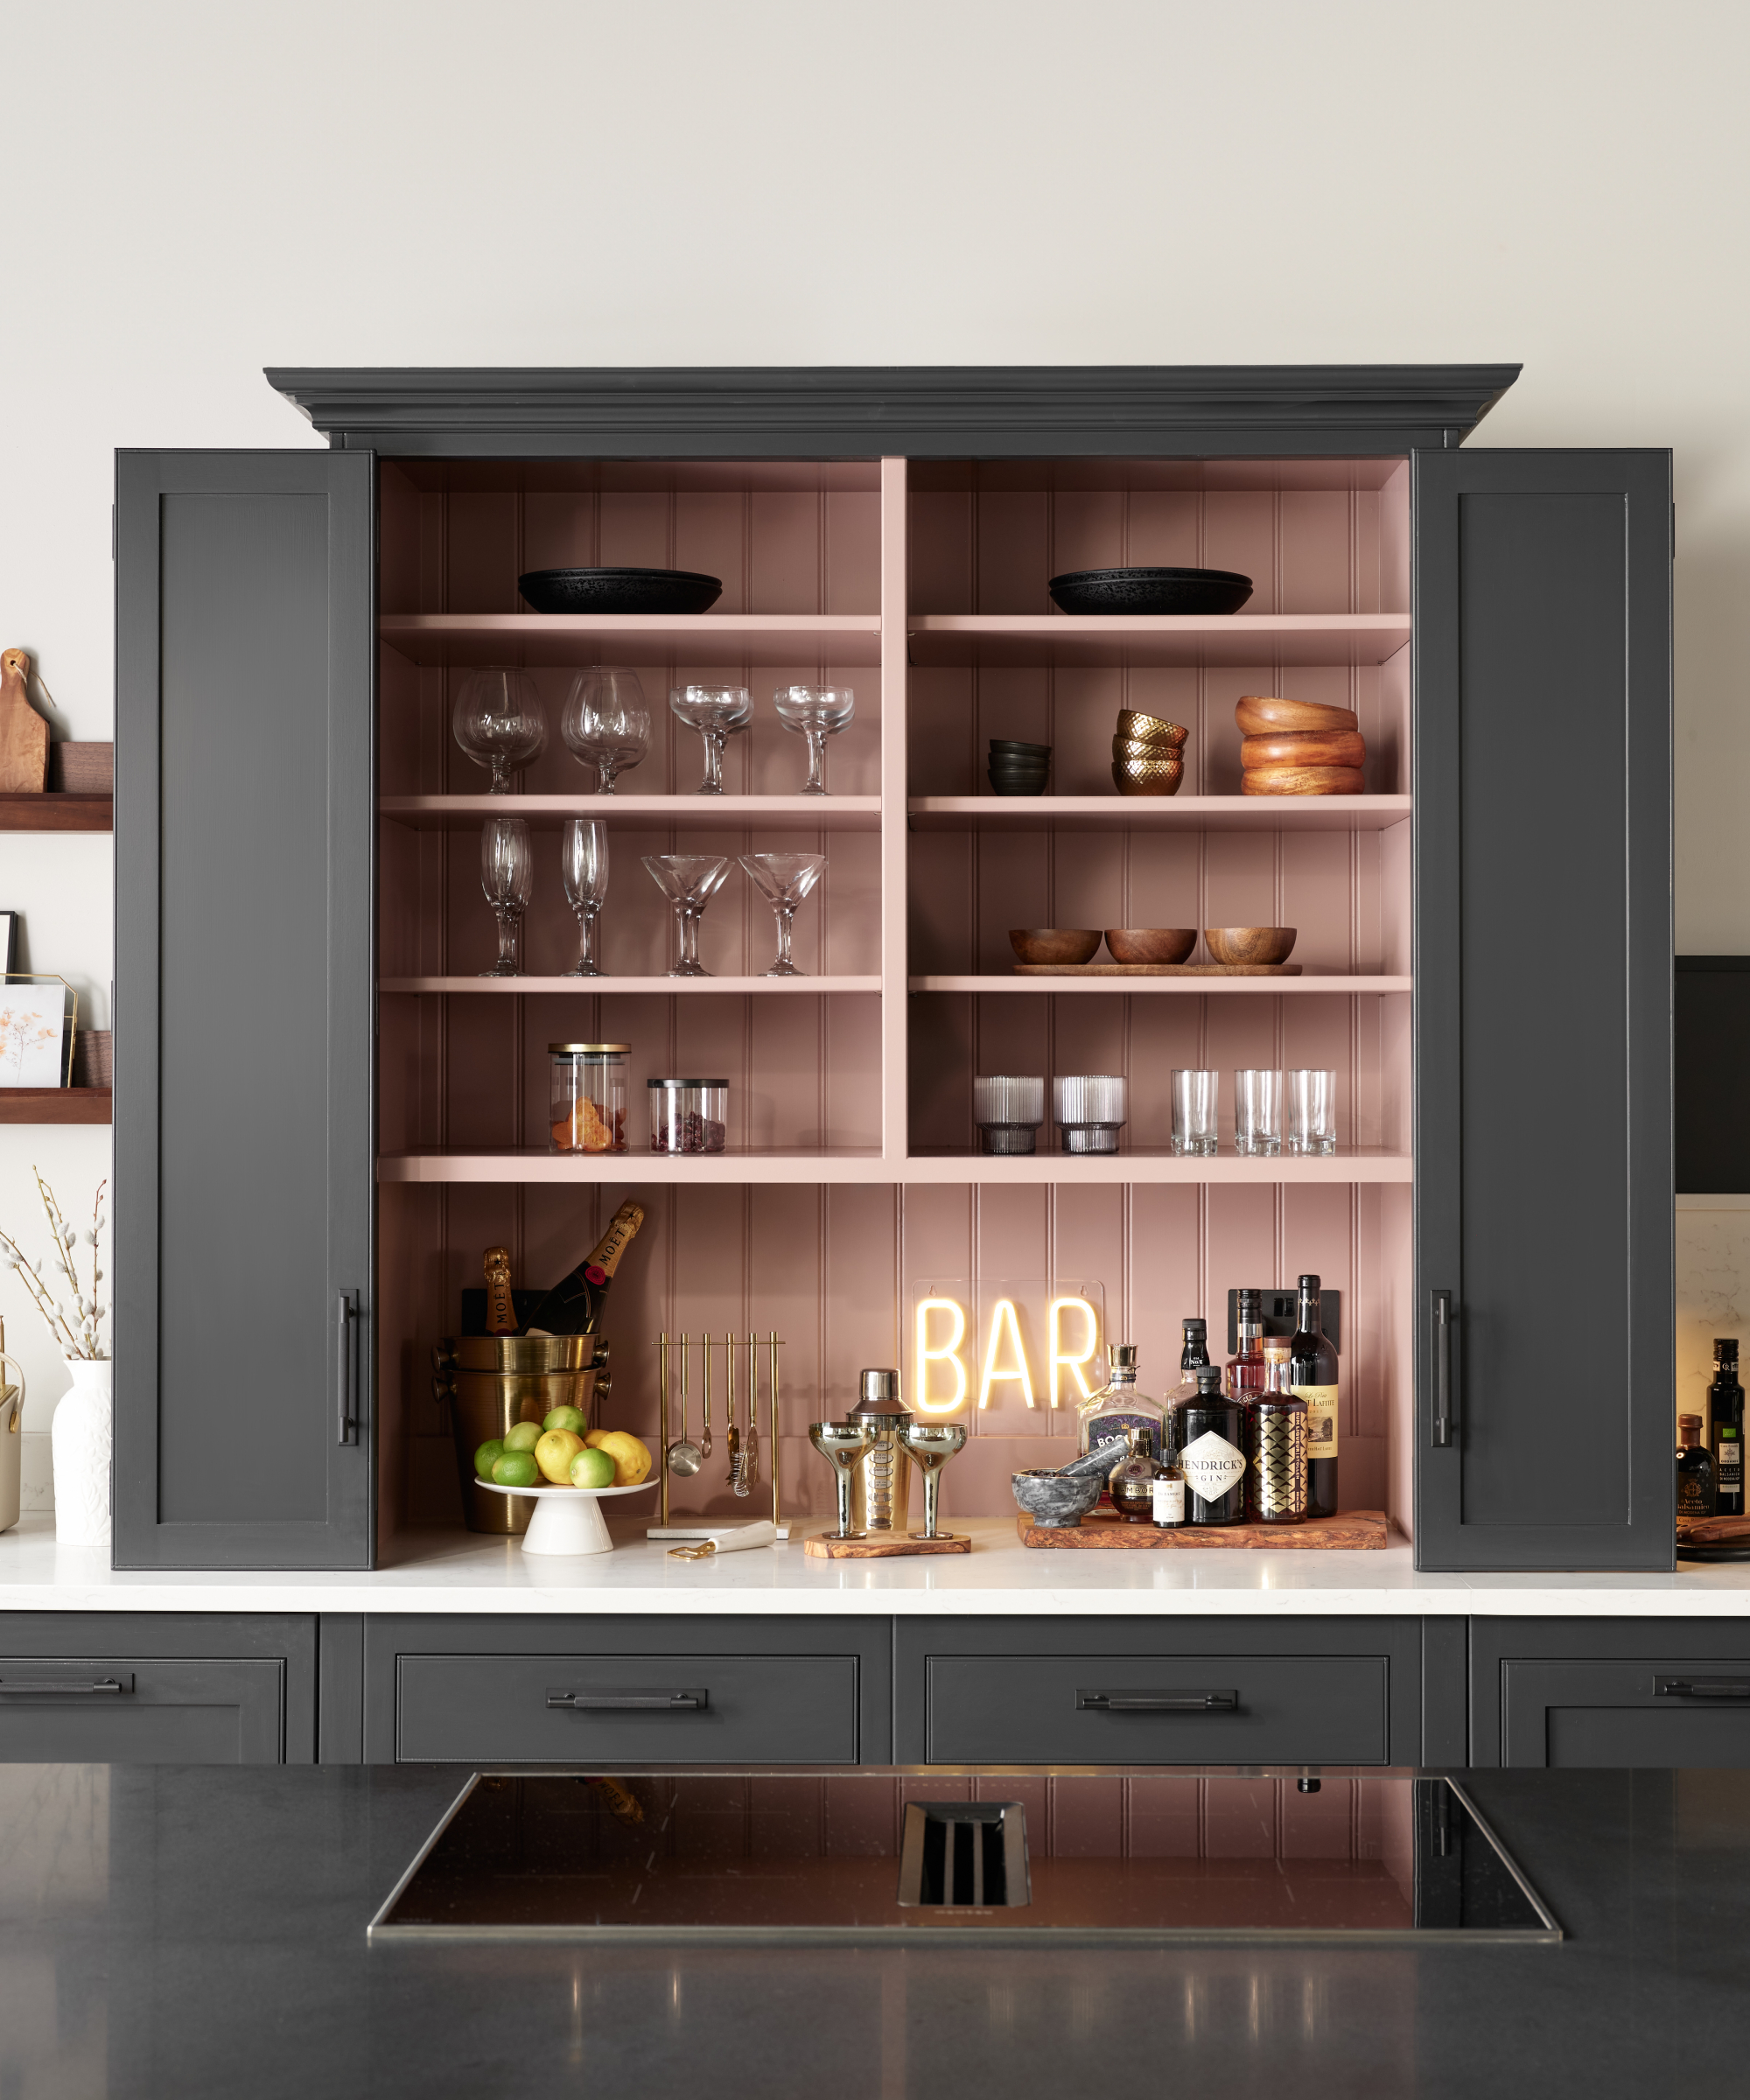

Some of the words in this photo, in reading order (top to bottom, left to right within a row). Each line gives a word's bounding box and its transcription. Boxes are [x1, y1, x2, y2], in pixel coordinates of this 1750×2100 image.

[598, 1228, 626, 1266] MOËT
[494, 1282, 508, 1324] MOËT
[916, 1298, 1097, 1413] BAR
[1177, 1459, 1242, 1471] HENDRICK'S
